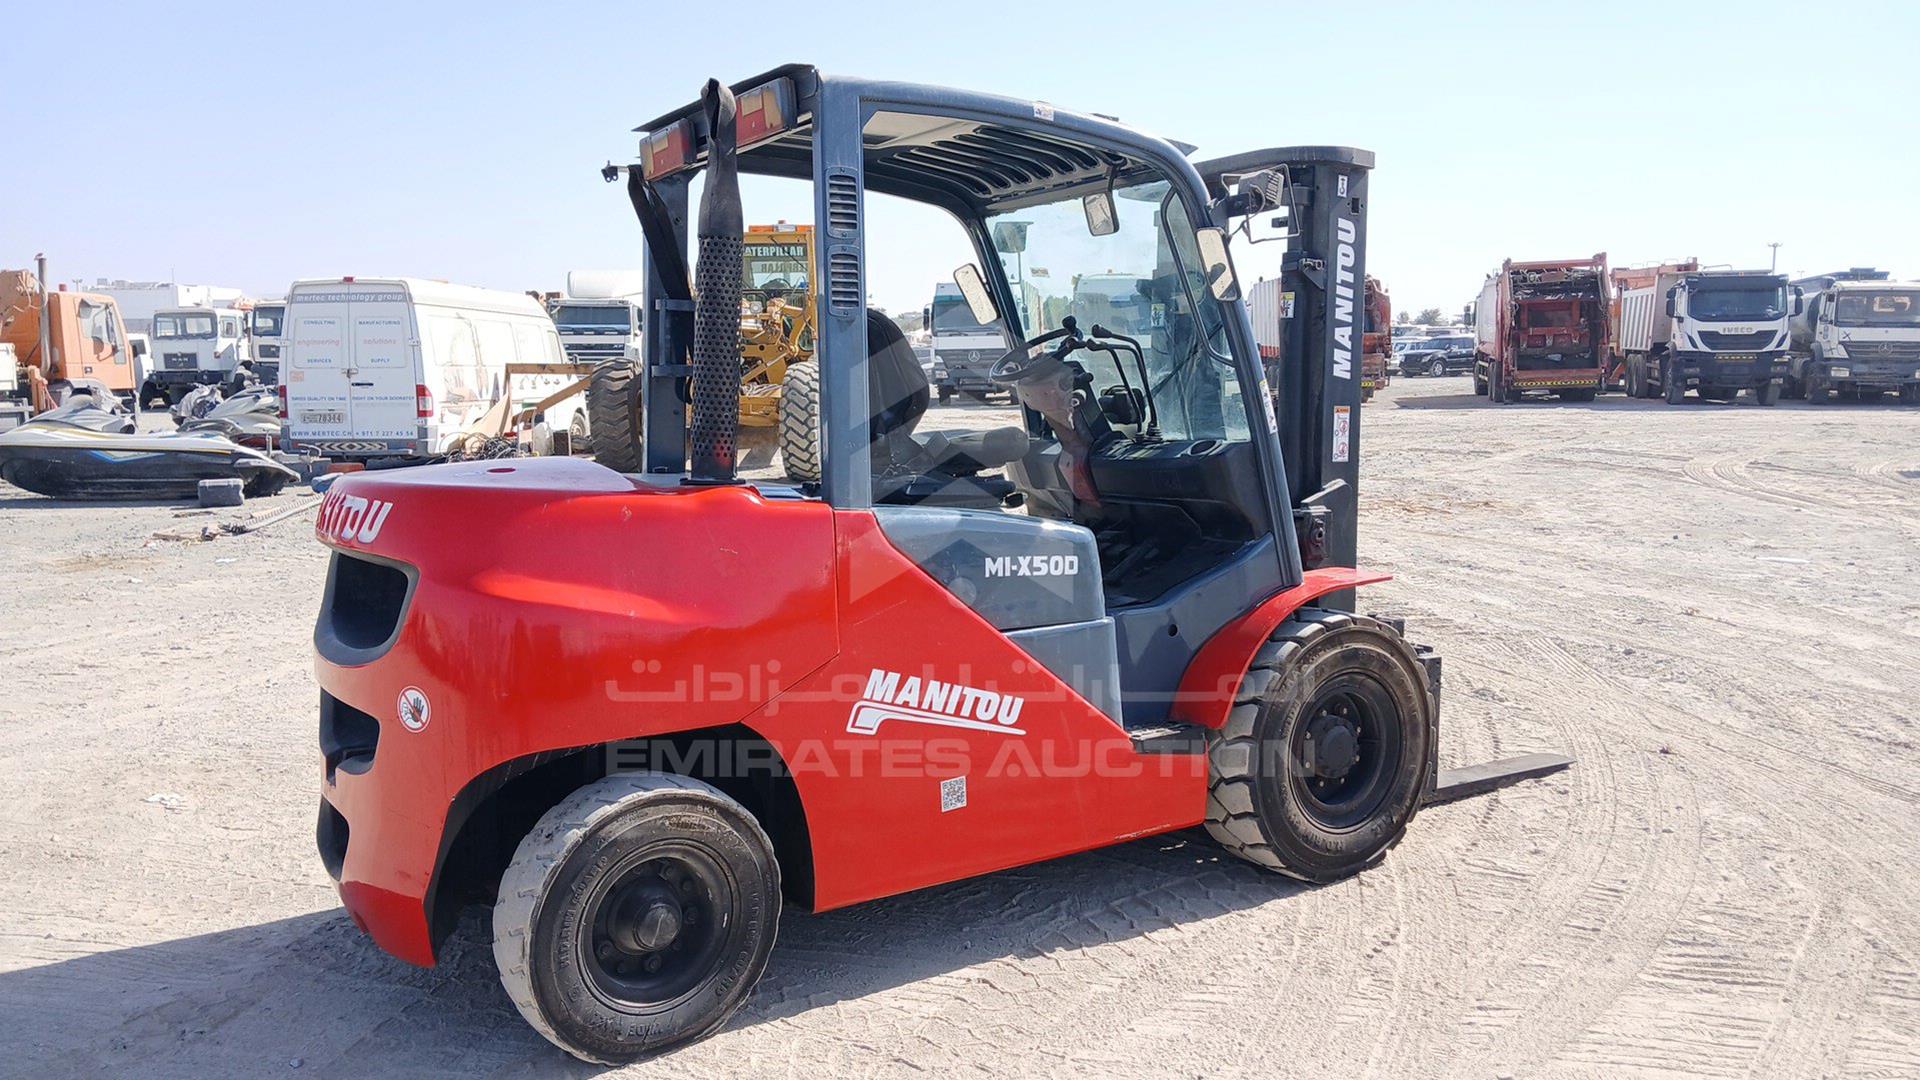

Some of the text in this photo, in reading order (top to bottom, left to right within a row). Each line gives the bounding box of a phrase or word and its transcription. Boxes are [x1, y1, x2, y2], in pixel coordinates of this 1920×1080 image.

[744, 246, 804, 256] ATERPILLAR
[297, 293, 403, 302] mertec technology group
[1333, 217, 1356, 380] MANITOU
[297, 338, 340, 347] engineering
[984, 555, 1079, 578] MI-X50D
[862, 667, 1025, 726] MANITOU
